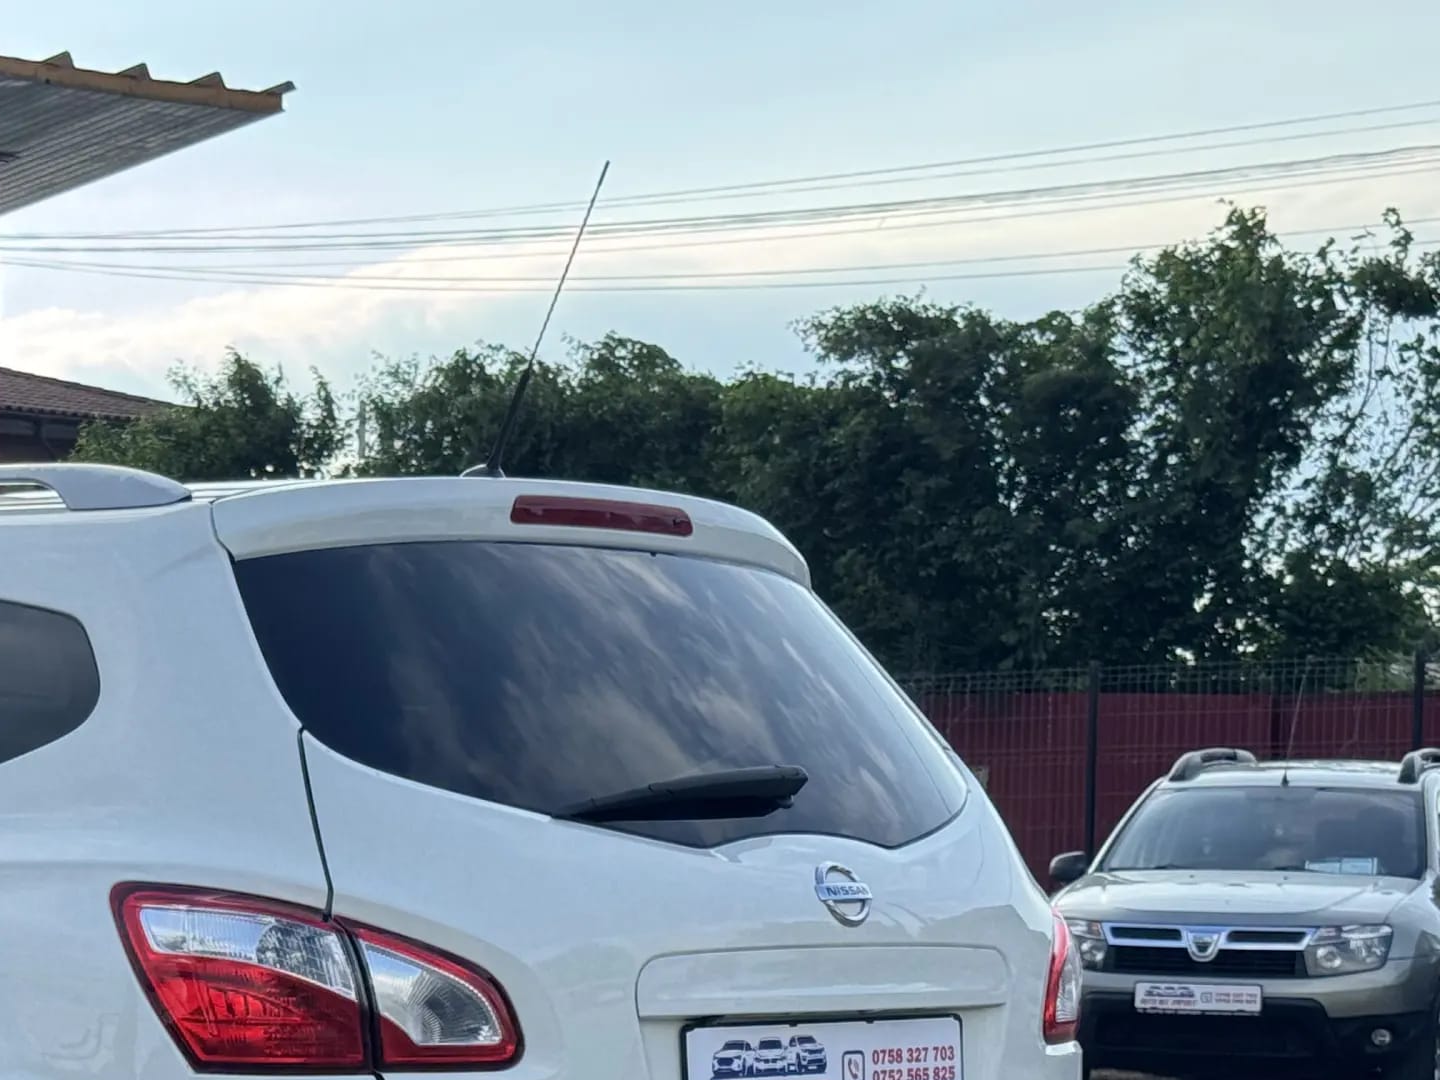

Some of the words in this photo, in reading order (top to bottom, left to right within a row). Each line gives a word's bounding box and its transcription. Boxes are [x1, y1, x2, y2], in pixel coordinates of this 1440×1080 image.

[872, 1048, 903, 1065] 0758
[907, 1047, 929, 1063] 327
[933, 1046, 955, 1061] 703
[933, 1065, 955, 1080] 825
